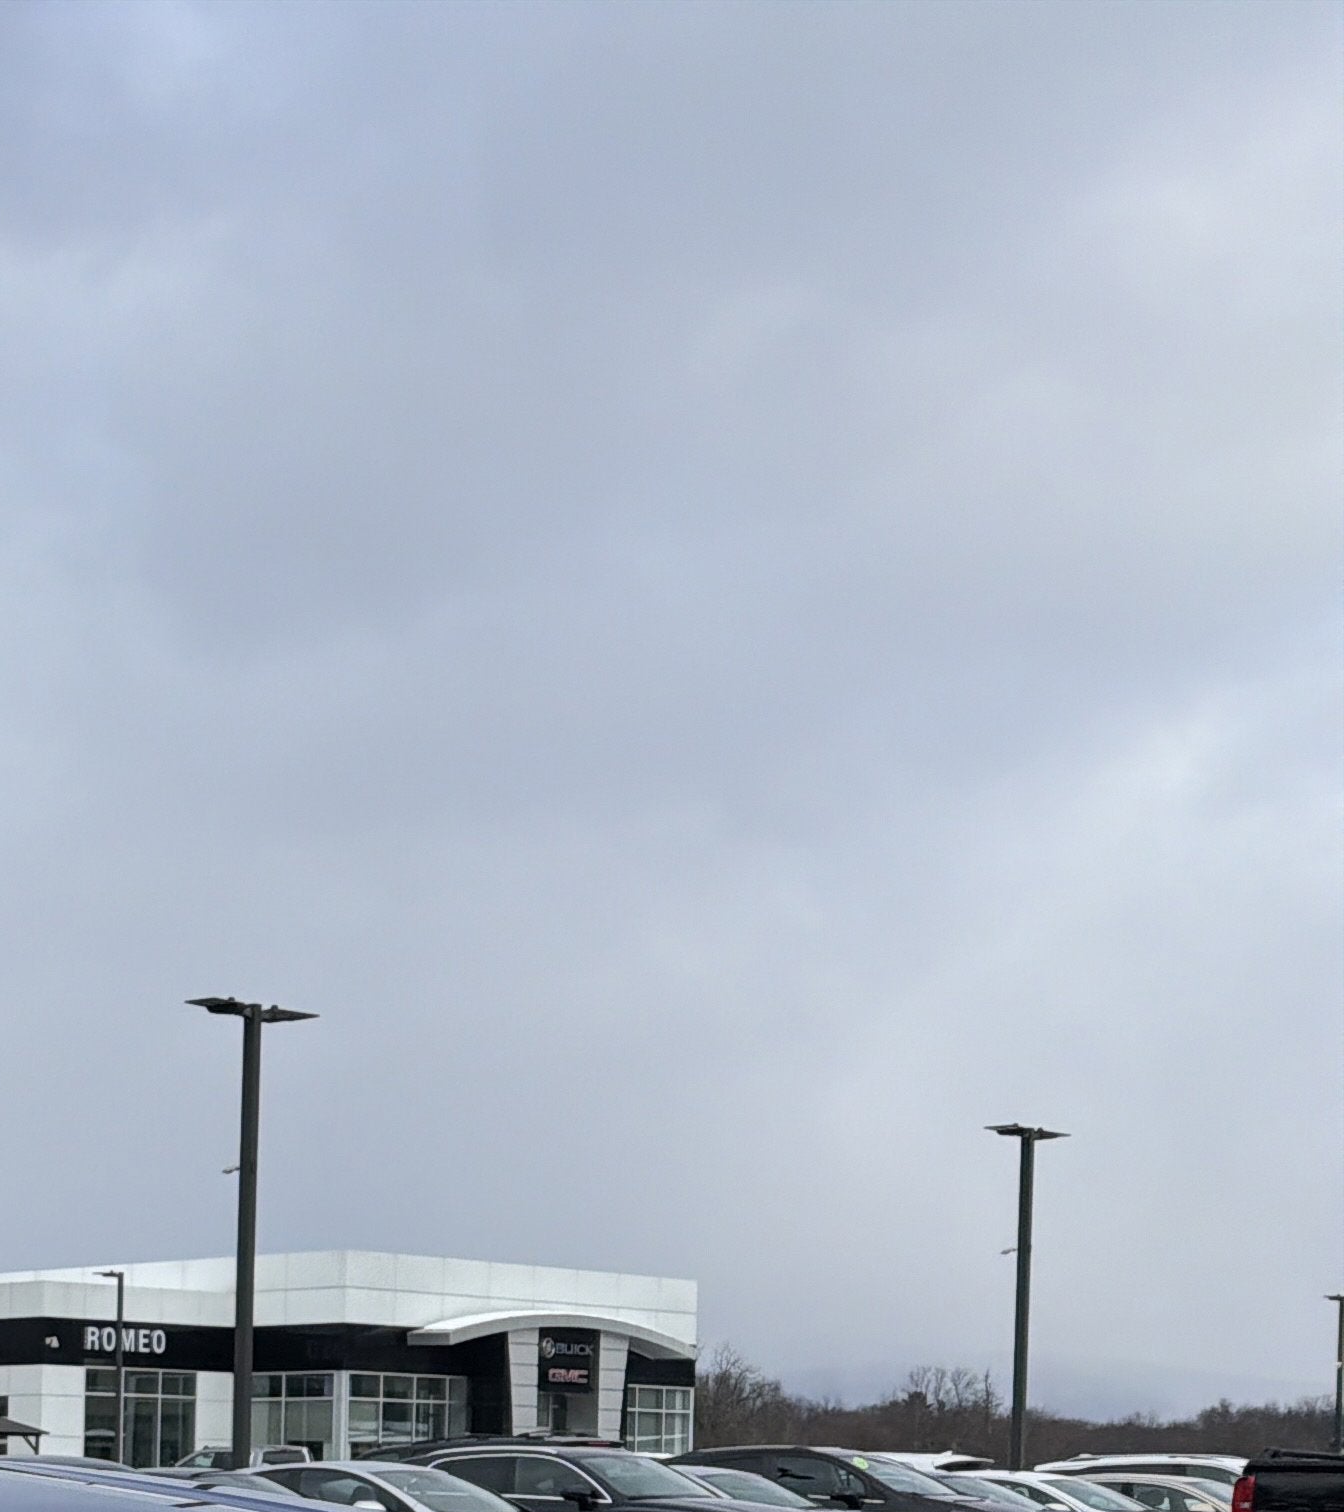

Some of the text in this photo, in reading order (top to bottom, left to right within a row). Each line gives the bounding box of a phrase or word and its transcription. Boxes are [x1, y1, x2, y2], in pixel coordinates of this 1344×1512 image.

[84, 1326, 166, 1354] ROMEO
[555, 1342, 594, 1356] BUICK
[548, 1368, 589, 1384] GMC
